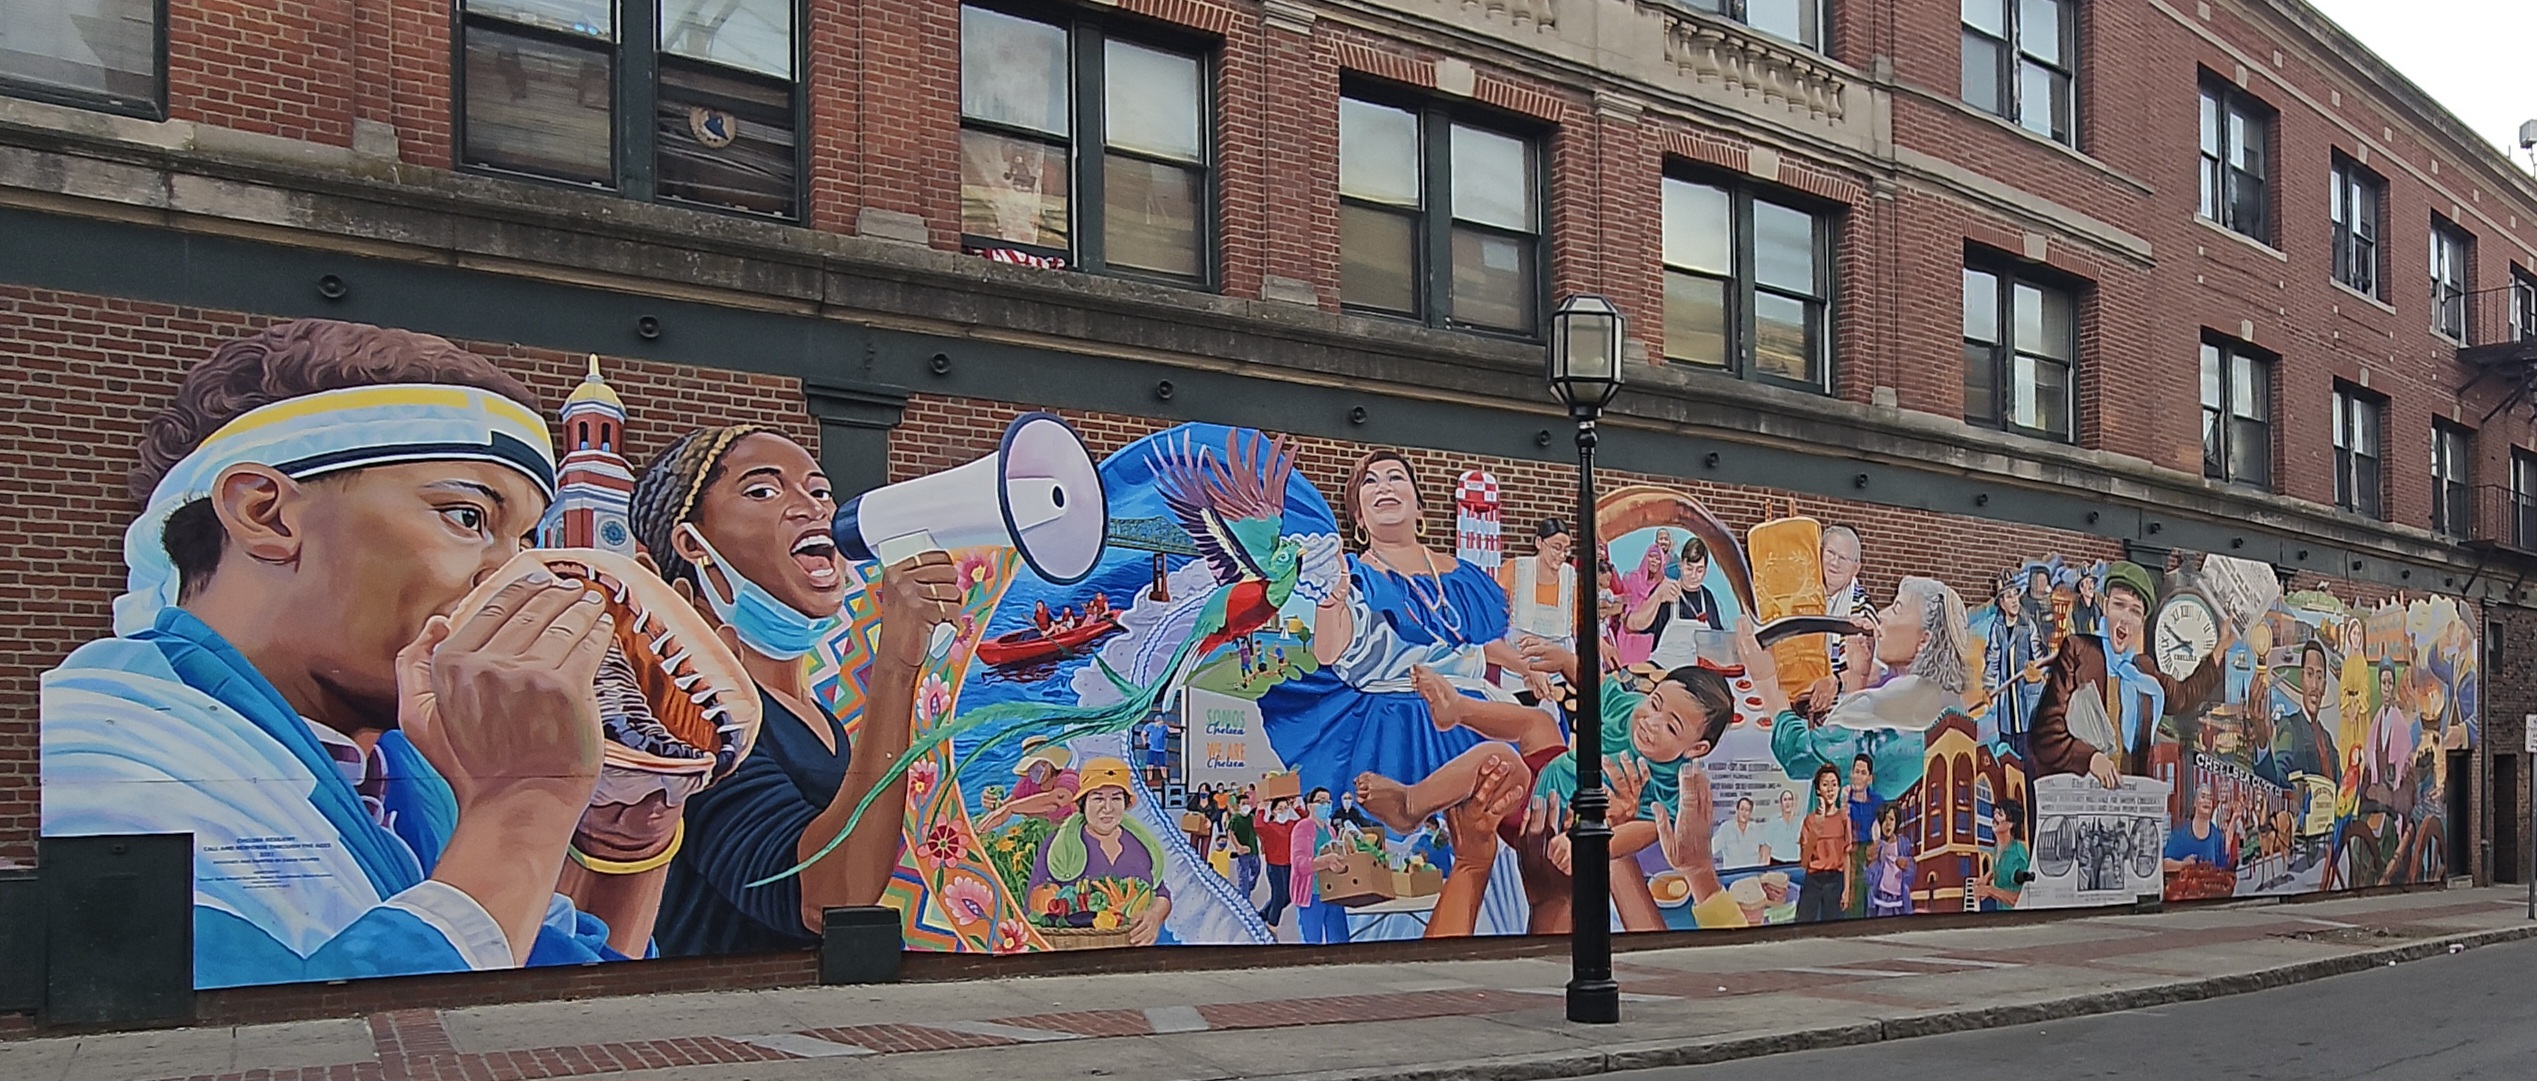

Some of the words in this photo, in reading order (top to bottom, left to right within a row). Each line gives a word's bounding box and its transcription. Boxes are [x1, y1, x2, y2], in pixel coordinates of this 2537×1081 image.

[1206, 709, 1245, 729] SOMOS
[1206, 720, 1246, 736] Chelsea
[1207, 742, 1222, 760] WE
[1227, 742, 1246, 760] ARE
[1207, 755, 1245, 769] Chelsea
